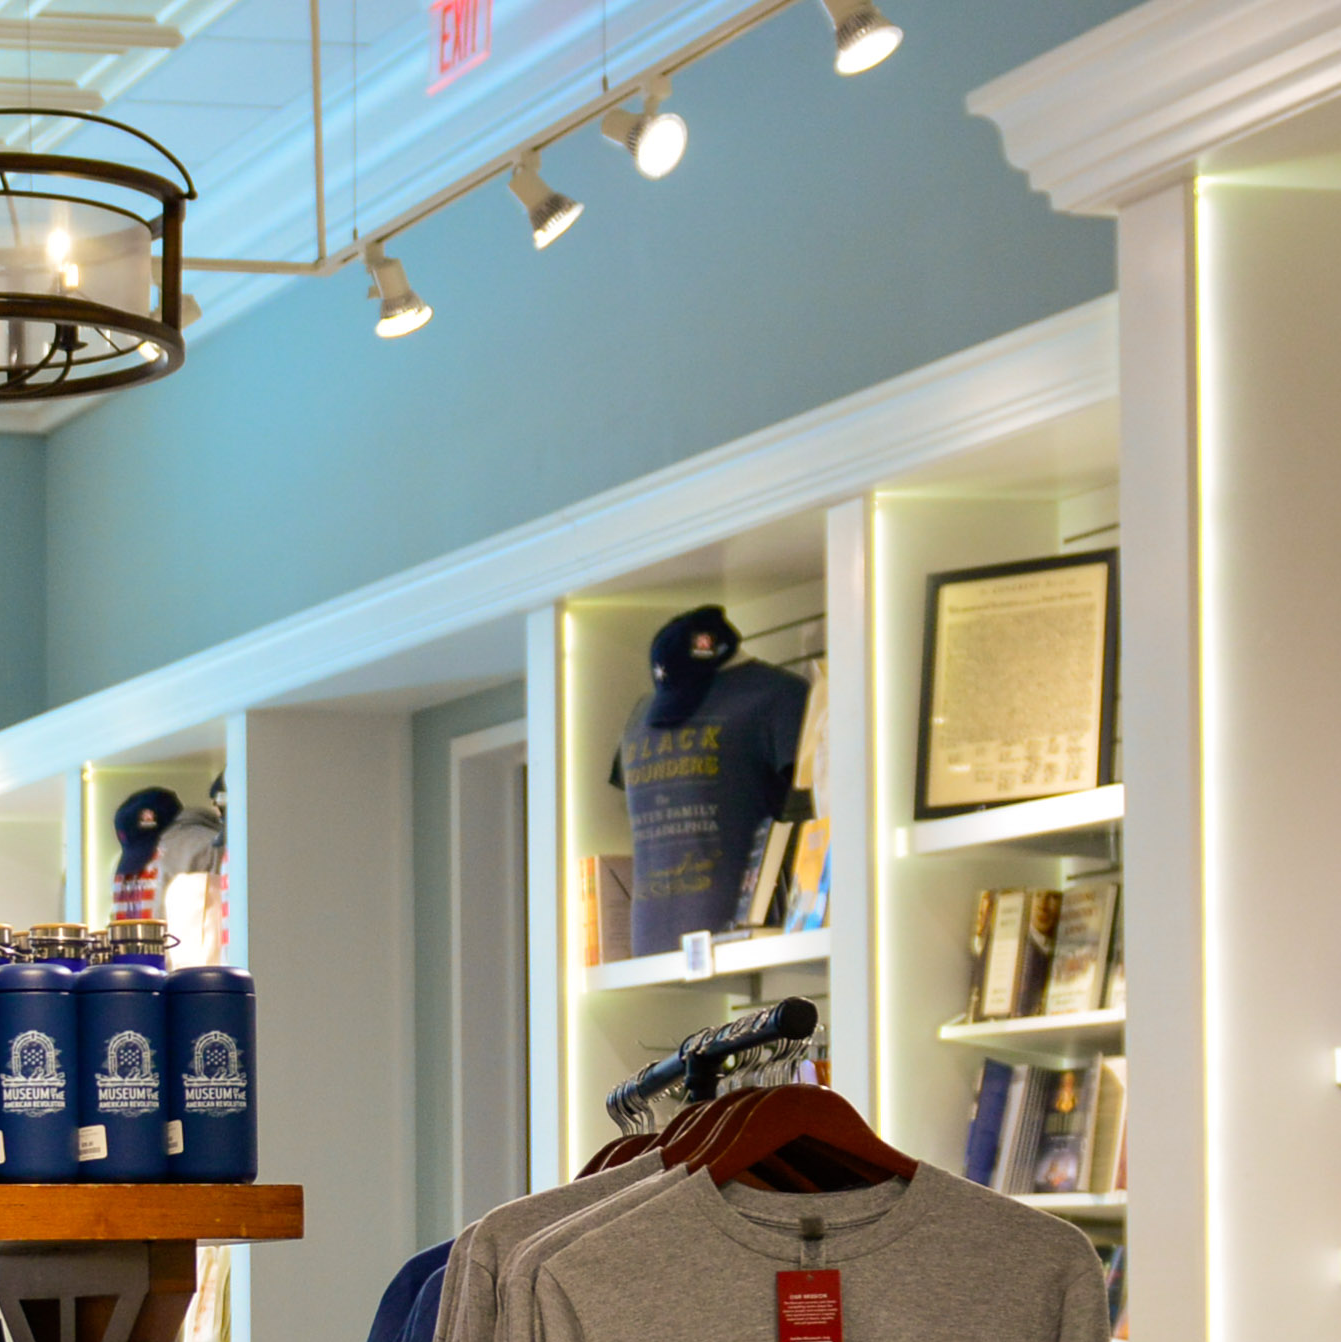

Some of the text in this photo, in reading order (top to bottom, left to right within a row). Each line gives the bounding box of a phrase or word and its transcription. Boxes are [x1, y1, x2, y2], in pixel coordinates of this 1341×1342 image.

[3, 1087, 50, 1101] MUSEUM
[98, 1087, 146, 1101] MUSEUM
[185, 1087, 232, 1101] MUSEUM
